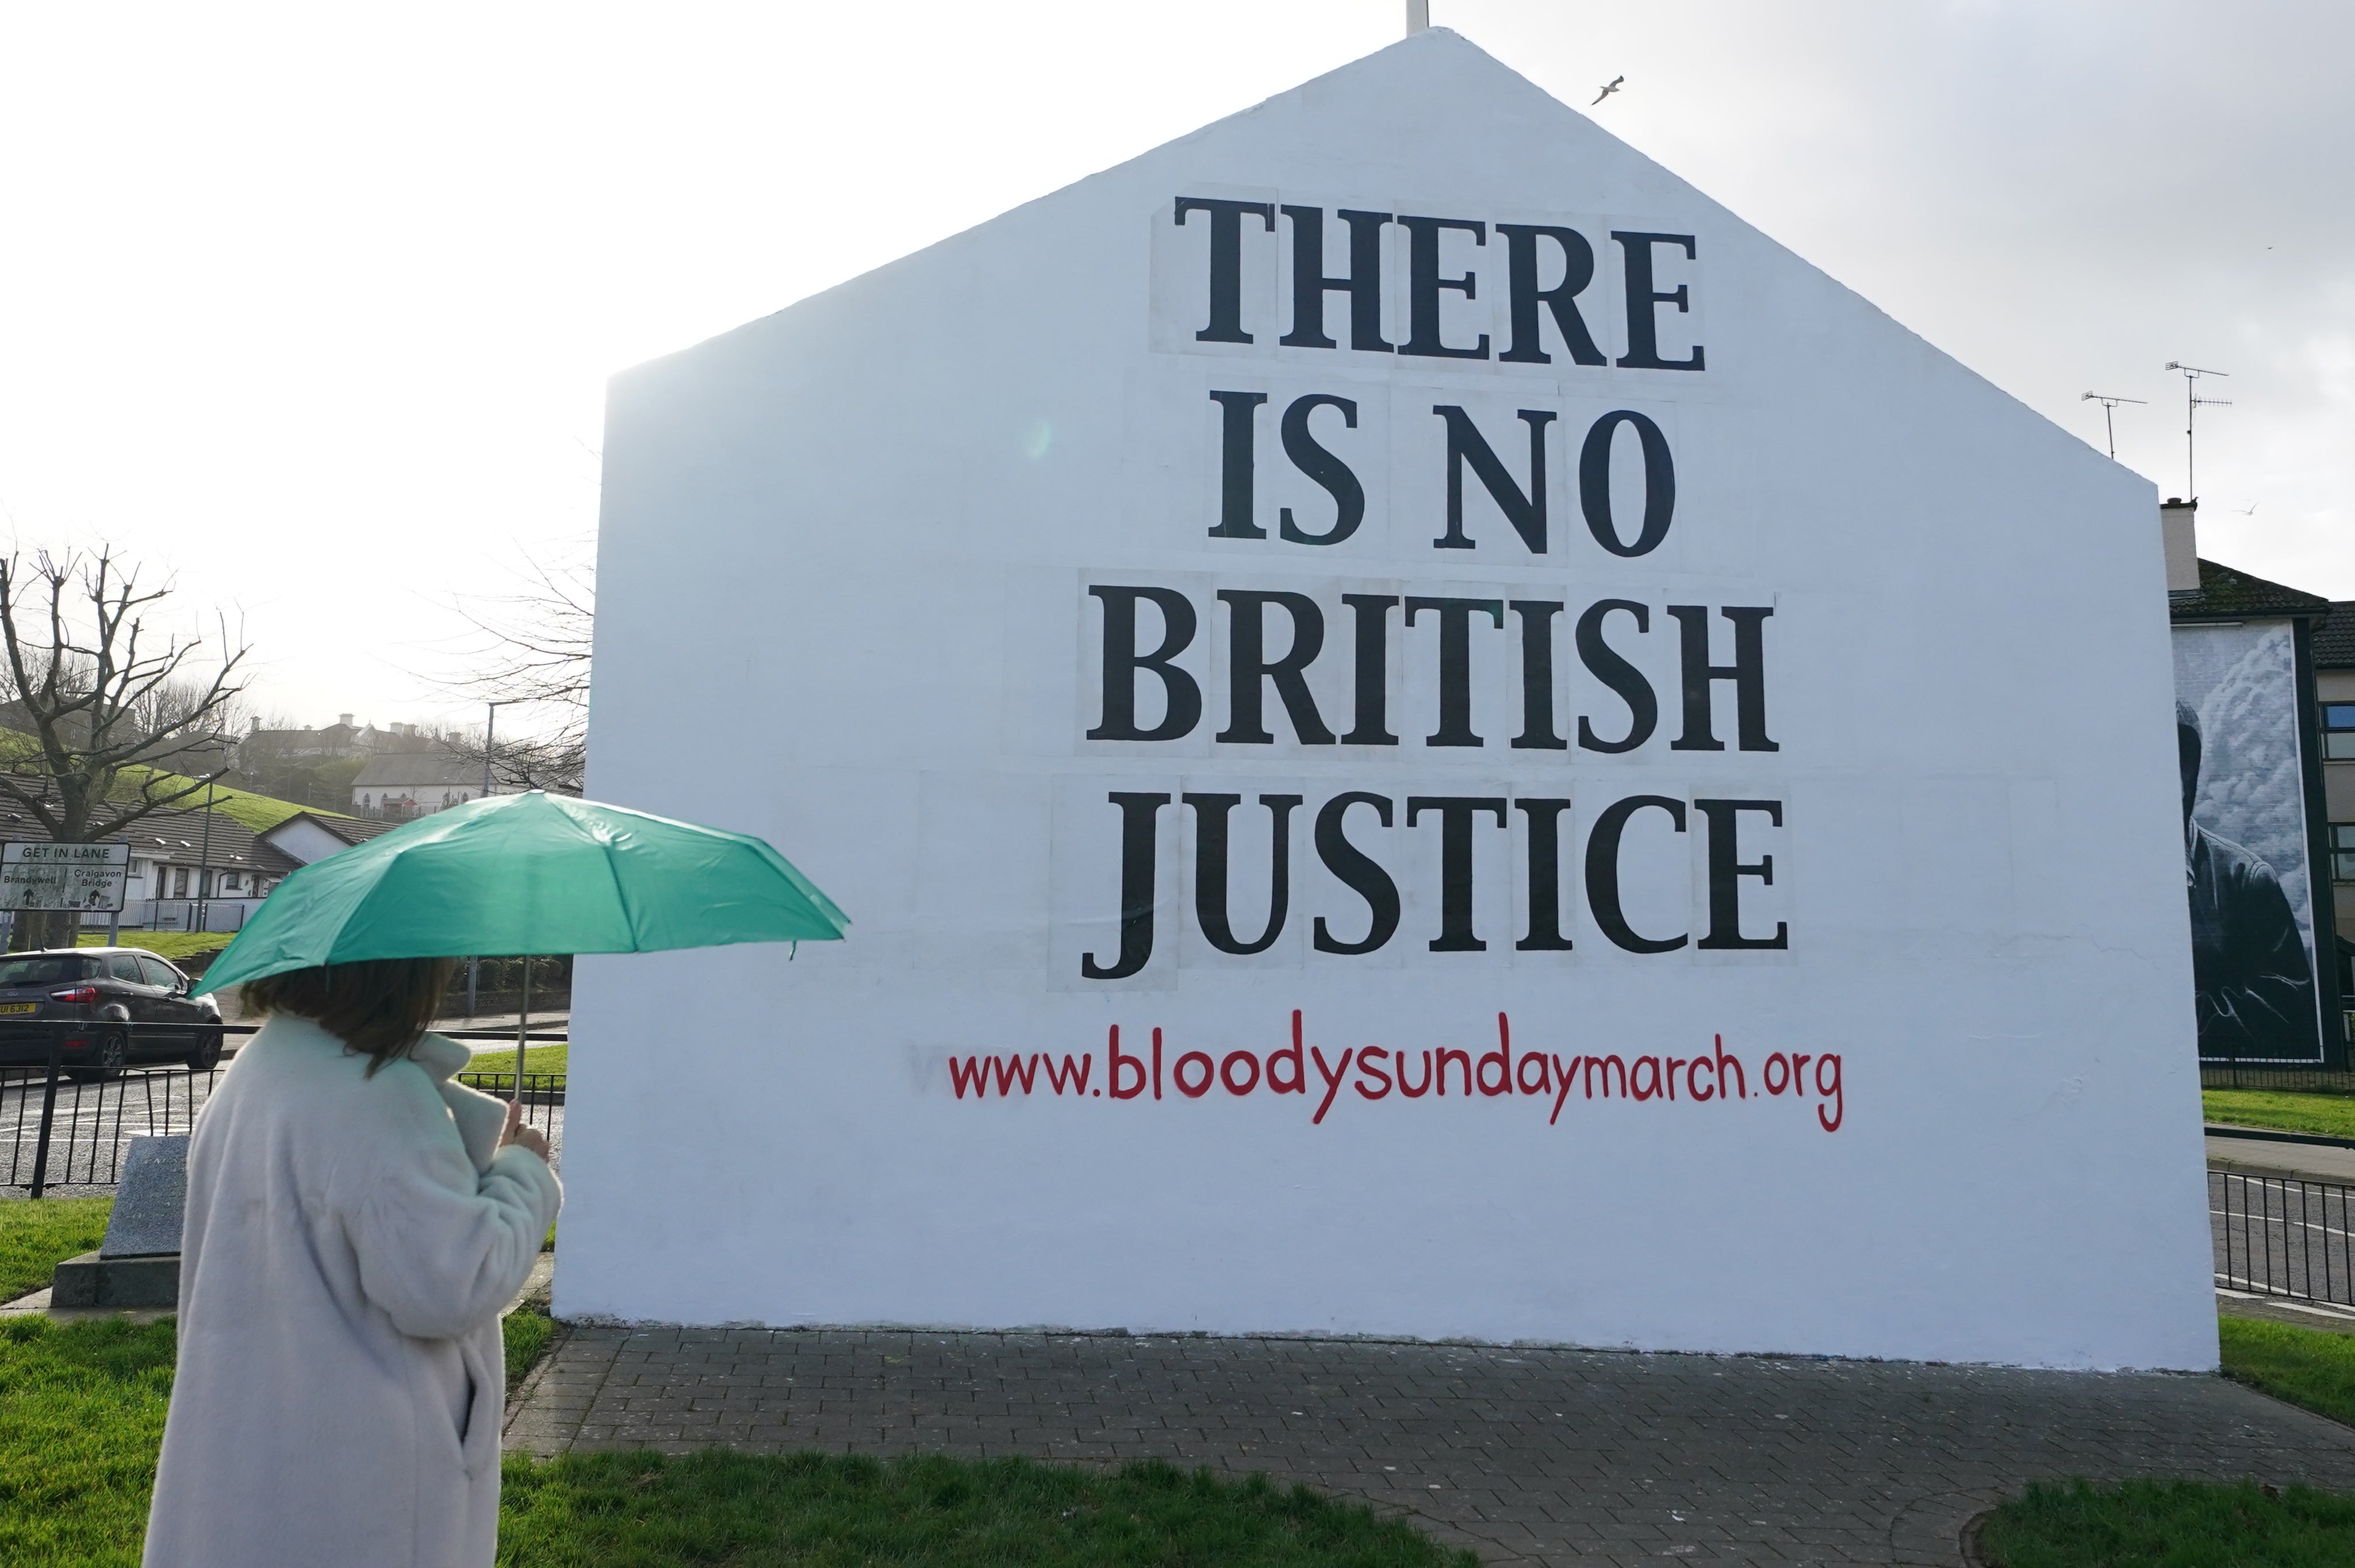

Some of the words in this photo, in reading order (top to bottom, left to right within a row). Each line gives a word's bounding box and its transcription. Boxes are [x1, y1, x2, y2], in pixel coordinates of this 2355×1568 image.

[1173, 195, 1706, 372] THERE
[1207, 389, 1366, 547] IS
[1432, 404, 1676, 558] NO
[1086, 584, 1780, 755] BRITISH
[3, 875, 57, 885] Brandywell
[22, 847, 49, 858] GET
[53, 848, 68, 858] IN
[74, 848, 110, 859] LANE
[74, 868, 122, 879] Craigavon
[81, 879, 113, 889] Bridge
[1081, 790, 1789, 981] JUSTICE
[0, 1005, 9, 1013] UI
[10, 1004, 29, 1013] 6312
[948, 1009, 1844, 1133] www.bloodysundaymarch.org
